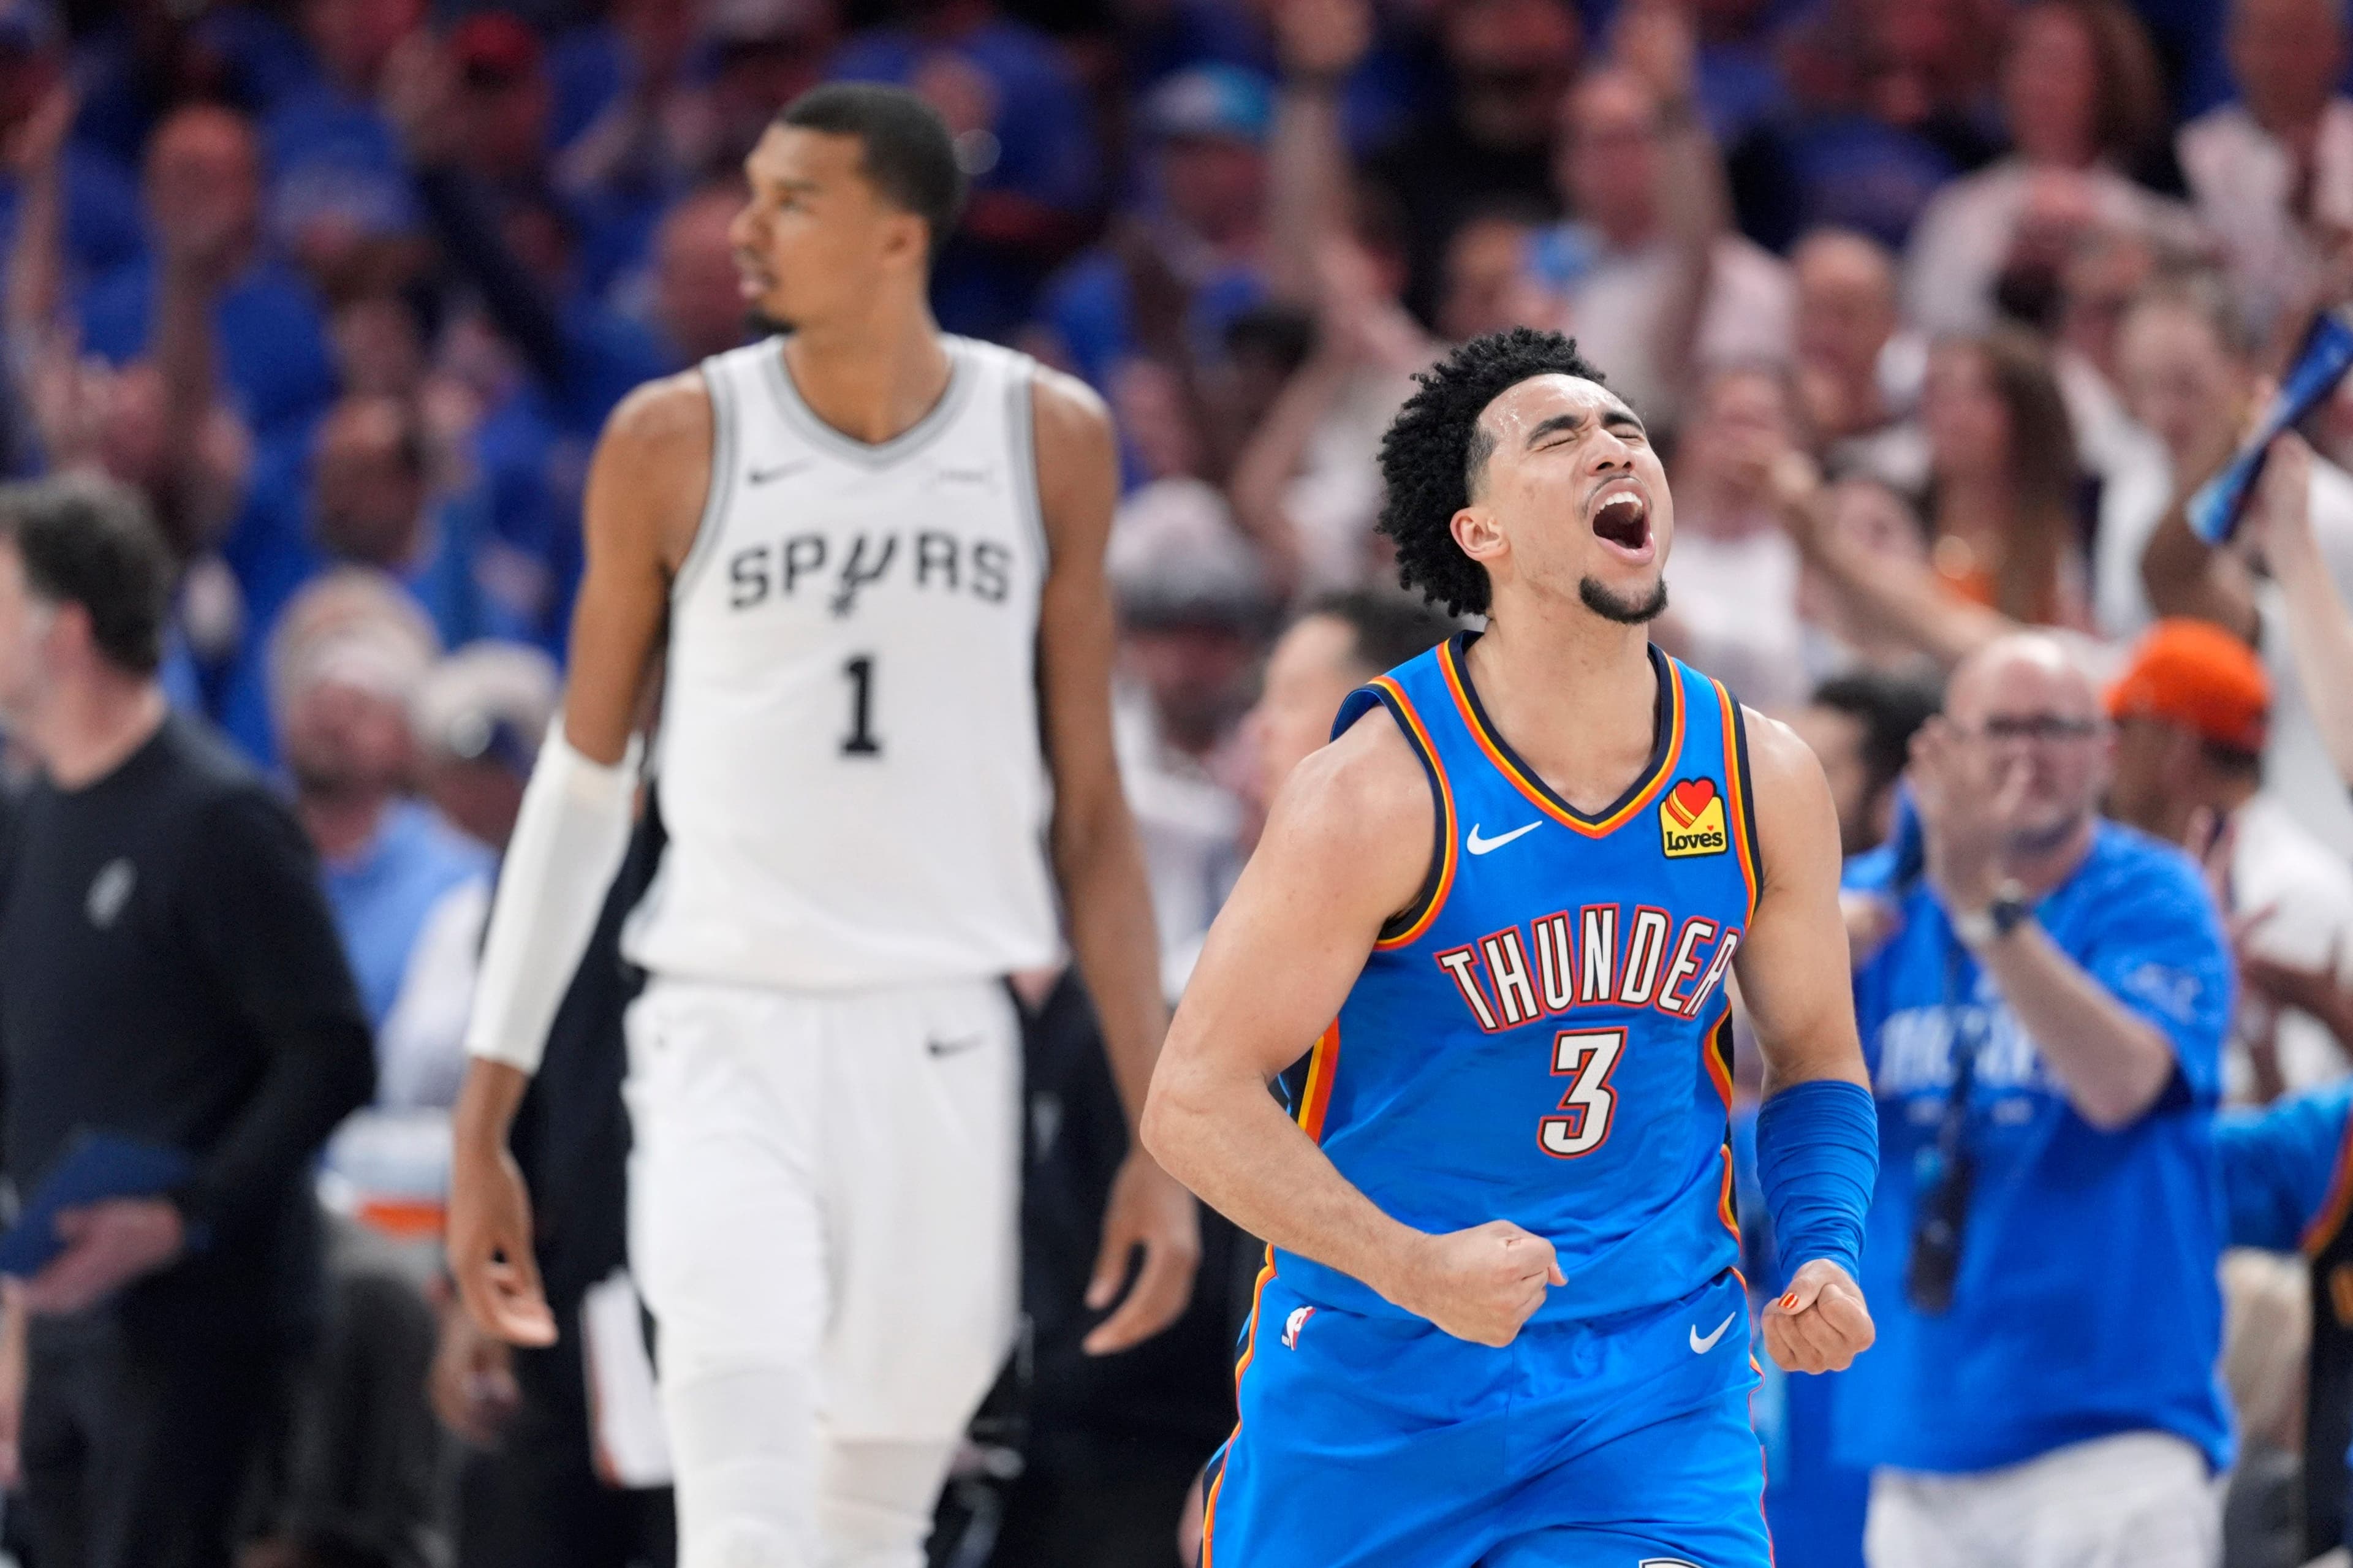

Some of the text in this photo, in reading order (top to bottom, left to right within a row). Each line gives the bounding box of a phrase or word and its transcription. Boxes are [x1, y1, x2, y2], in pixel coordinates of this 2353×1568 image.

[730, 532, 1012, 616] SPURS
[840, 654, 882, 757] 1
[1433, 903, 1741, 1034] THUNDER
[1537, 1026, 1627, 1159] 3
